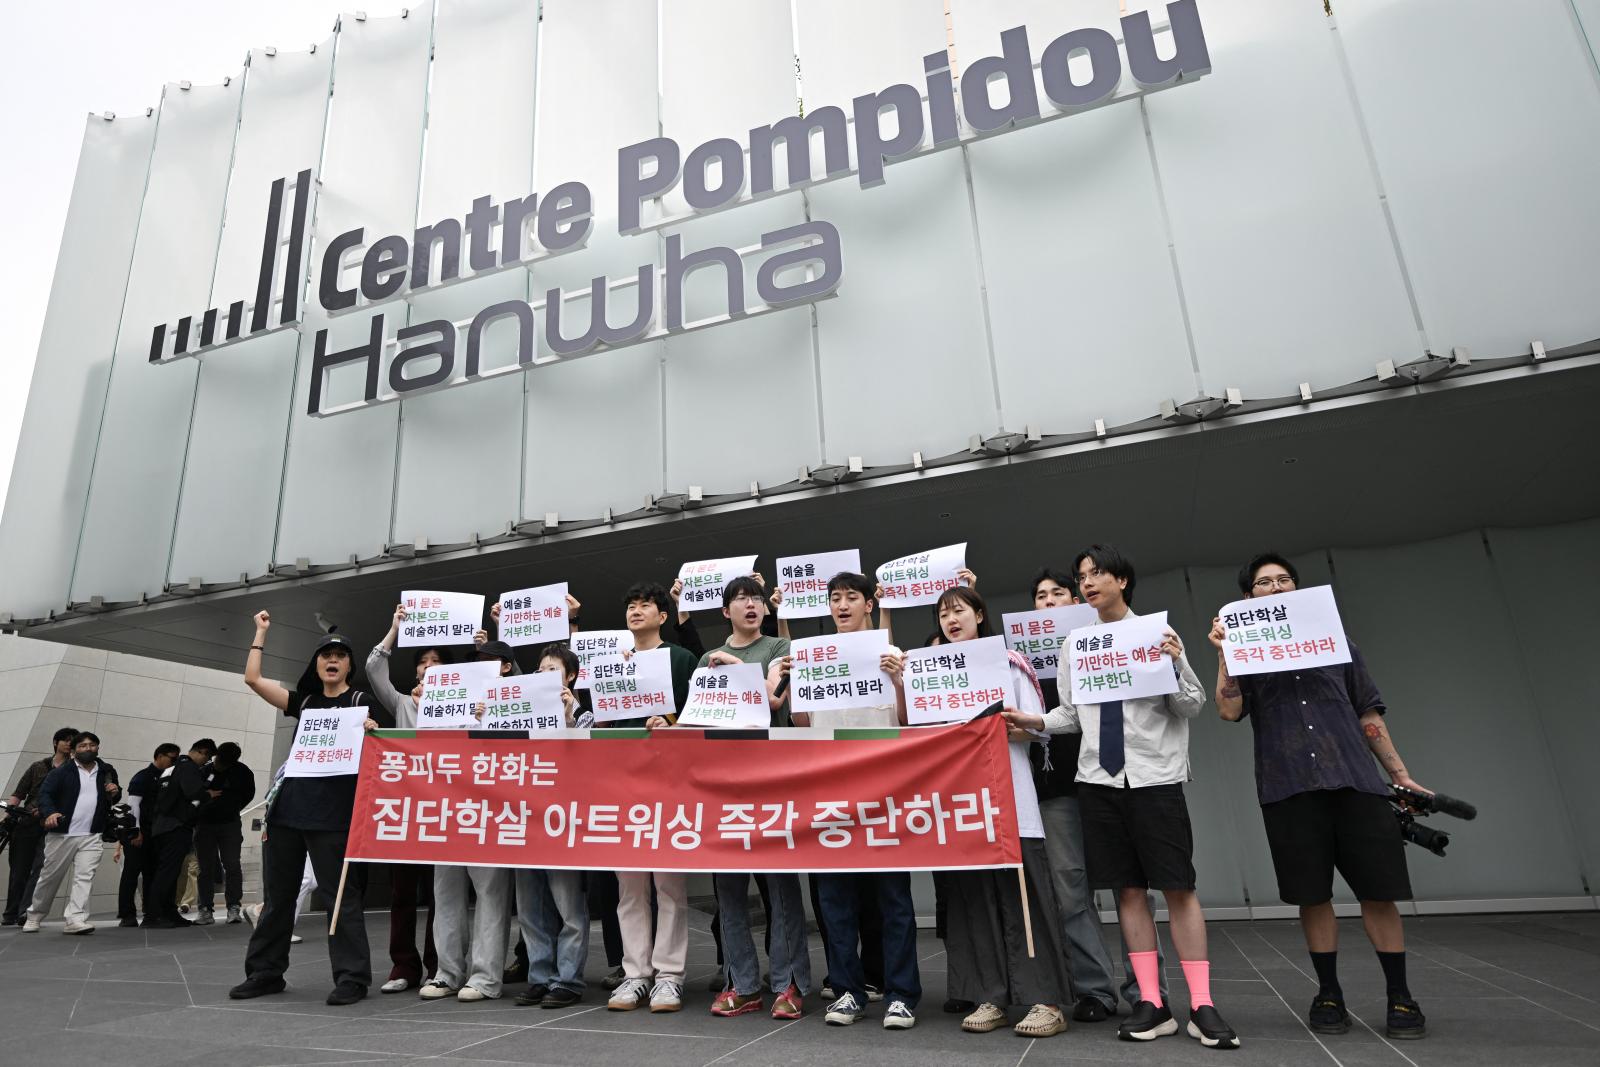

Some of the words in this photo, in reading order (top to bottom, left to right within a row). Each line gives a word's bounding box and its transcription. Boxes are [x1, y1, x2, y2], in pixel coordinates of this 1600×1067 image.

[319, 181, 593, 311] Centre
[618, 0, 1212, 237] Pompidou
[306, 220, 843, 416] Hanwha
[782, 563, 815, 579] 예술을
[882, 565, 929, 583] 아트워싱
[684, 573, 723, 588] 자본으로
[783, 579, 828, 594] 기만하는
[885, 585, 907, 599] 즉각
[911, 577, 960, 597] 중단하라
[406, 598, 416, 609] 피
[420, 597, 442, 609] 묻은
[503, 596, 532, 610] 예술을
[684, 586, 724, 603] 예술하지
[784, 593, 830, 609] 거부한다
[406, 611, 449, 623] 자본으로
[504, 609, 541, 624] 기만하는
[543, 606, 563, 618] 예술
[1224, 604, 1288, 629] 집단학살
[404, 624, 448, 637] 예술하지
[452, 623, 474, 636] 말라
[504, 624, 542, 638] 거부한다
[1011, 622, 1024, 636] 피
[1028, 619, 1055, 636] 묻은
[1228, 623, 1293, 645] 아트워싱
[576, 636, 619, 651] 집단학살
[1013, 636, 1067, 654] 자본으로
[1076, 633, 1114, 653] 예술을
[1233, 646, 1265, 664] 즉각
[1269, 636, 1336, 661] 중단하라
[796, 649, 809, 664] 피
[812, 645, 838, 662] 묻은
[1077, 651, 1128, 673] 기만하는
[1131, 645, 1161, 664] 예술
[593, 662, 636, 679] 집단학살
[910, 653, 966, 674] 집단학살
[427, 674, 437, 686] 피
[440, 673, 460, 686] 묻은
[797, 663, 851, 682] 자본으로
[1079, 670, 1133, 692] 거부한다
[594, 678, 637, 695] 아트워싱
[695, 675, 729, 689] 예술을
[798, 681, 852, 701] 예술하지
[855, 678, 884, 696] 말라
[911, 672, 969, 693] 아트워싱
[425, 688, 467, 702] 자본으로
[487, 688, 497, 701] 피
[500, 685, 522, 699] 묻은
[597, 697, 618, 711] 즉각
[621, 691, 666, 710] 중단하라
[692, 691, 739, 705] 기만하는
[741, 690, 763, 705] 예술
[914, 694, 943, 711] 즉각
[946, 687, 1005, 709] 중단하라
[423, 703, 466, 718] 예술하지
[488, 702, 533, 718] 자본으로
[687, 707, 736, 721] 거부한다
[303, 717, 340, 731] 집단학살
[536, 715, 558, 729] 말라
[299, 734, 337, 747] 아트워싱
[294, 750, 315, 763] 즉각
[317, 748, 353, 763] 중단하라
[378, 751, 462, 784] 퐁피두
[471, 752, 559, 787] 한화는
[371, 796, 532, 846] 집단학살
[543, 801, 703, 850] 아트워싱
[717, 800, 799, 850] 즉각
[810, 787, 1000, 848] 중단하라
